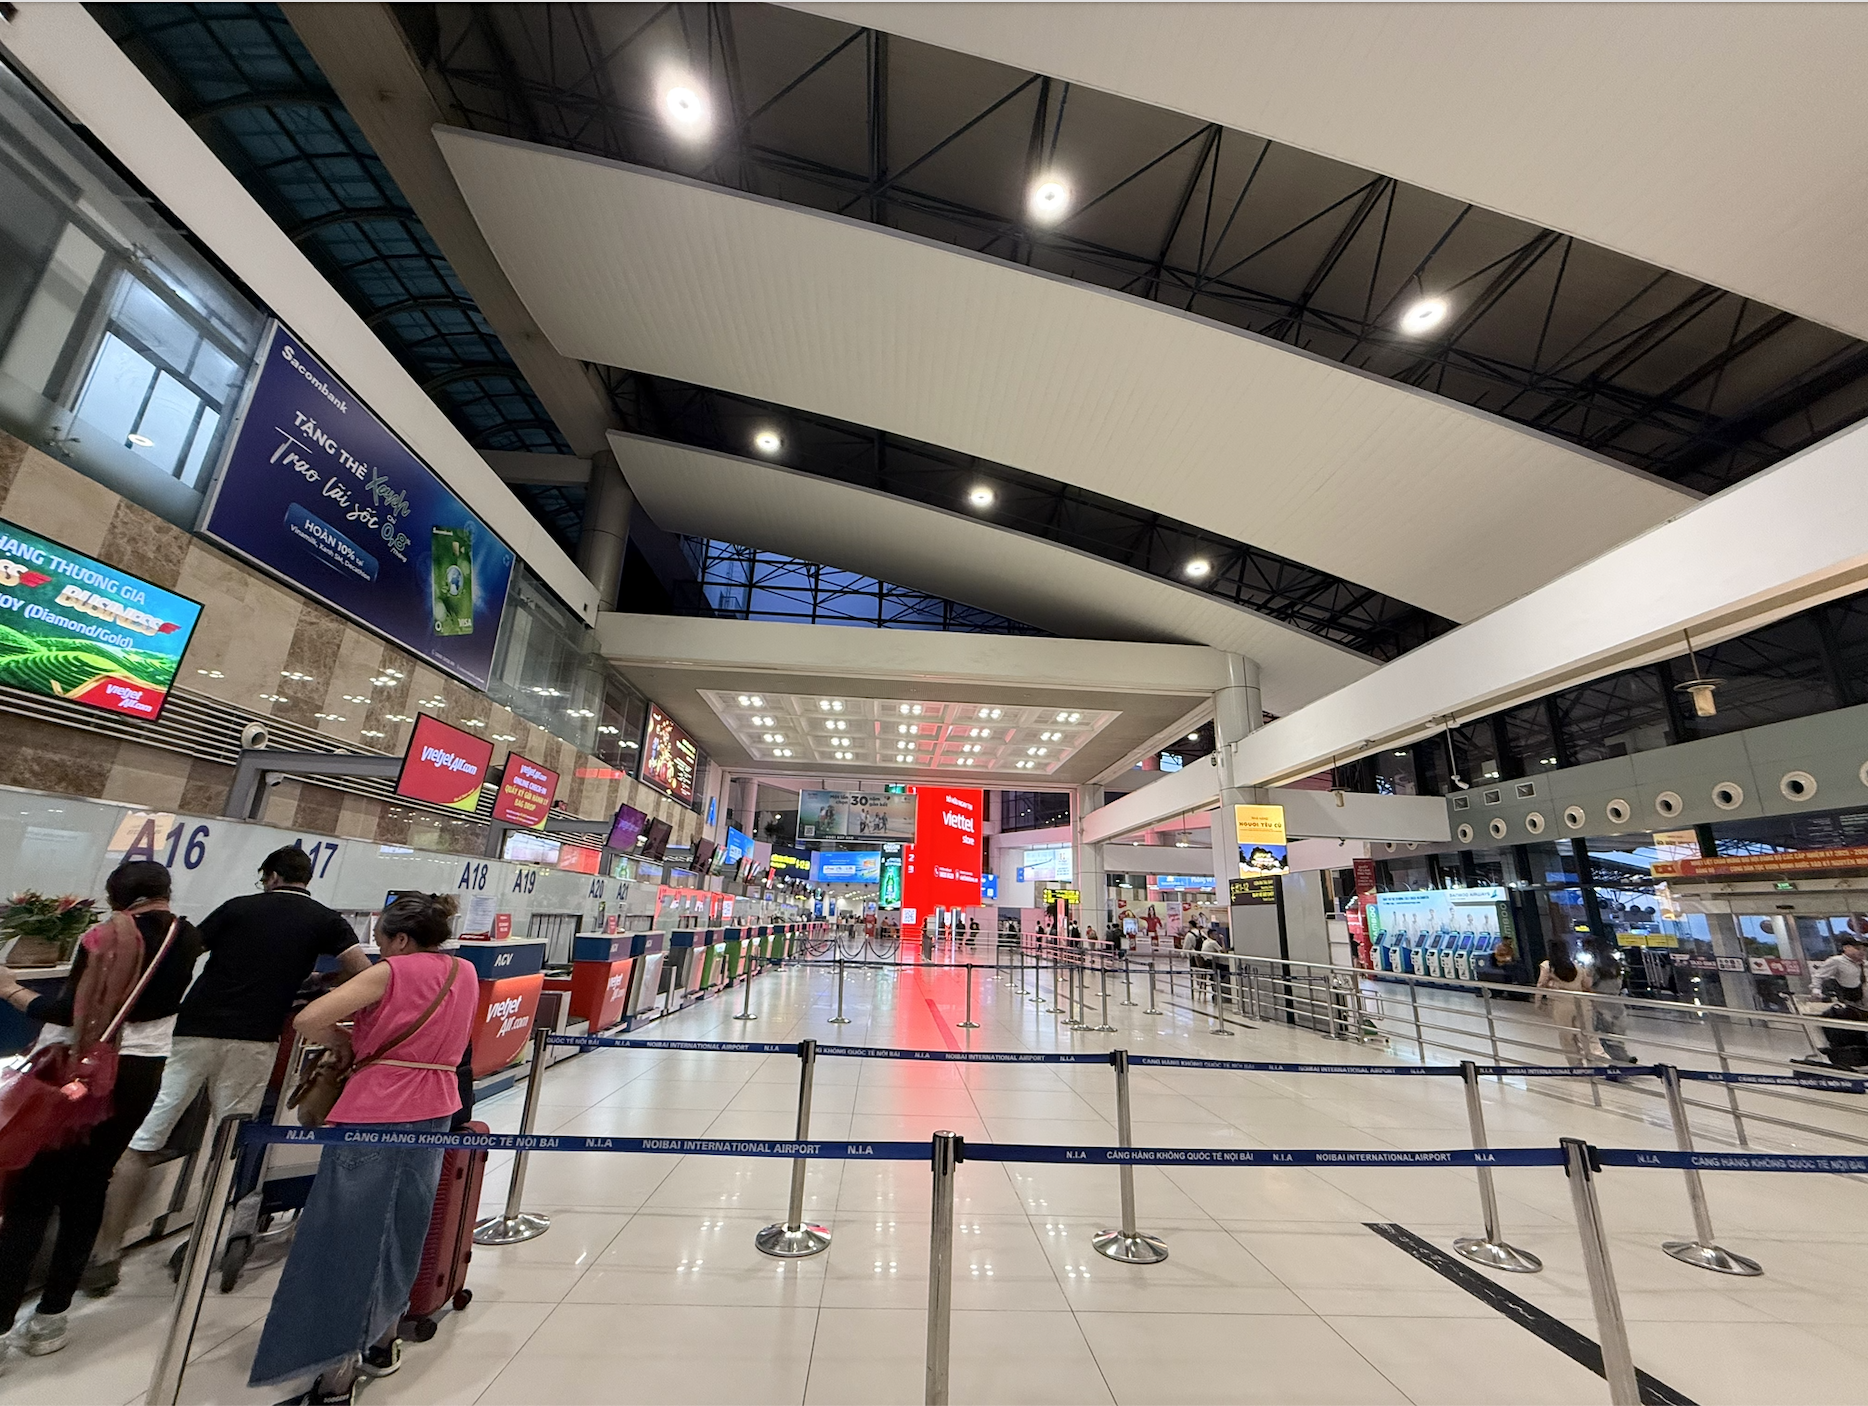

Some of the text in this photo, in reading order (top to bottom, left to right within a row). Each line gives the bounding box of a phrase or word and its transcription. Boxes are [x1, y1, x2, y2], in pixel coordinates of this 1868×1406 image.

[281, 345, 348, 414] Sacombank
[293, 410, 338, 455] TẶNG
[339, 449, 368, 480] THẺ
[304, 519, 337, 547] HOÀN
[337, 541, 357, 561] 10%
[120, 585, 146, 605] GIA
[55, 584, 166, 637] BUSINESS
[23, 603, 134, 650] (Diamond/Gold)
[850, 795, 869, 806] 30
[942, 810, 975, 834] viettel
[120, 818, 210, 870] A16
[457, 861, 489, 891] A18
[512, 869, 537, 895] A19
[588, 878, 605, 899] A20
[616, 882, 630, 900] A21
[494, 953, 514, 967] ACV
[670, 1041, 720, 1051] INTERNATIONAL
[720, 1043, 750, 1051] AIRPORT
[764, 1044, 780, 1052] N.I.A
[968, 1053, 1017, 1061] INTERNATIONAL
[1018, 1054, 1046, 1062] AIRPORT
[286, 1129, 315, 1141] N.I.A
[381, 1131, 416, 1144] HÀNG
[418, 1132, 460, 1146] KHÔNG
[515, 1135, 537, 1149] NỘI
[539, 1136, 559, 1148] BÀI
[585, 1138, 613, 1148] N.I.A
[642, 1139, 681, 1150] NOIBAI
[683, 1141, 771, 1154] INTERNATIONAL
[773, 1143, 821, 1155] AIRPORT
[847, 1145, 874, 1155] N.I.A
[1066, 1150, 1087, 1159] N.I.A
[1131, 1149, 1155, 1160] HÀNG
[1156, 1150, 1186, 1160] KHÔNG
[1187, 1150, 1211, 1162] QUỐC
[1212, 1150, 1223, 1161] TẾ
[1223, 1151, 1239, 1162] NỘI
[1239, 1151, 1254, 1161] BÀI
[1272, 1153, 1294, 1162] N.I.A
[1315, 1153, 1347, 1162] NOIBAI
[1347, 1153, 1415, 1162] INTERNATIONAL
[1415, 1153, 1452, 1162] AIRPORT
[1474, 1153, 1496, 1162] N.I.A
[1637, 1153, 1661, 1165] N.I.A
